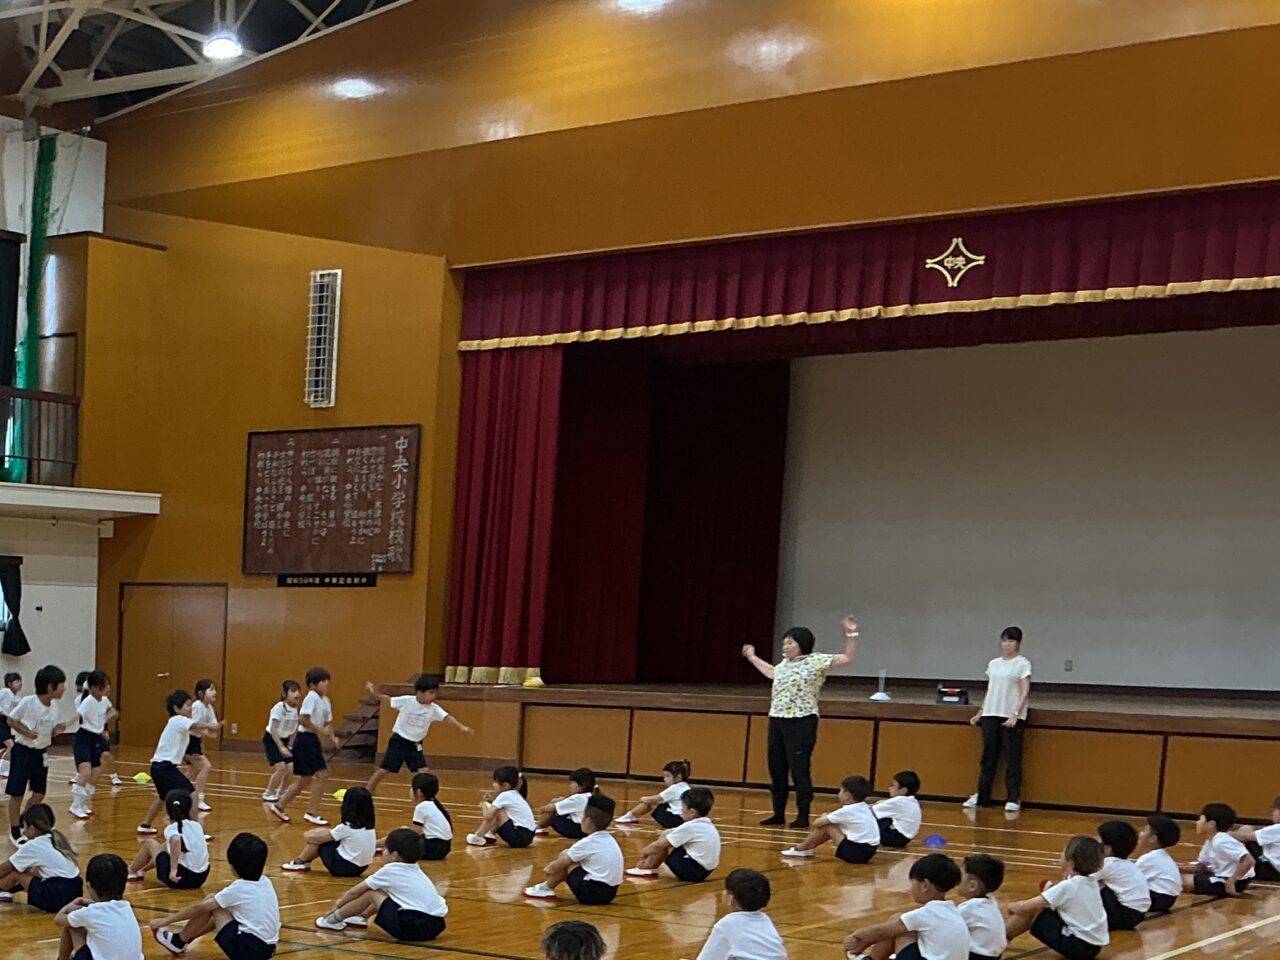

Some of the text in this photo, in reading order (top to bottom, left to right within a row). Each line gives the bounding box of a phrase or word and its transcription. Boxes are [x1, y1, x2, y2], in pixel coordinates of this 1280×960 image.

[943, 256, 966, 269] 中央
[387, 435, 409, 562] 中央小学校校歌
